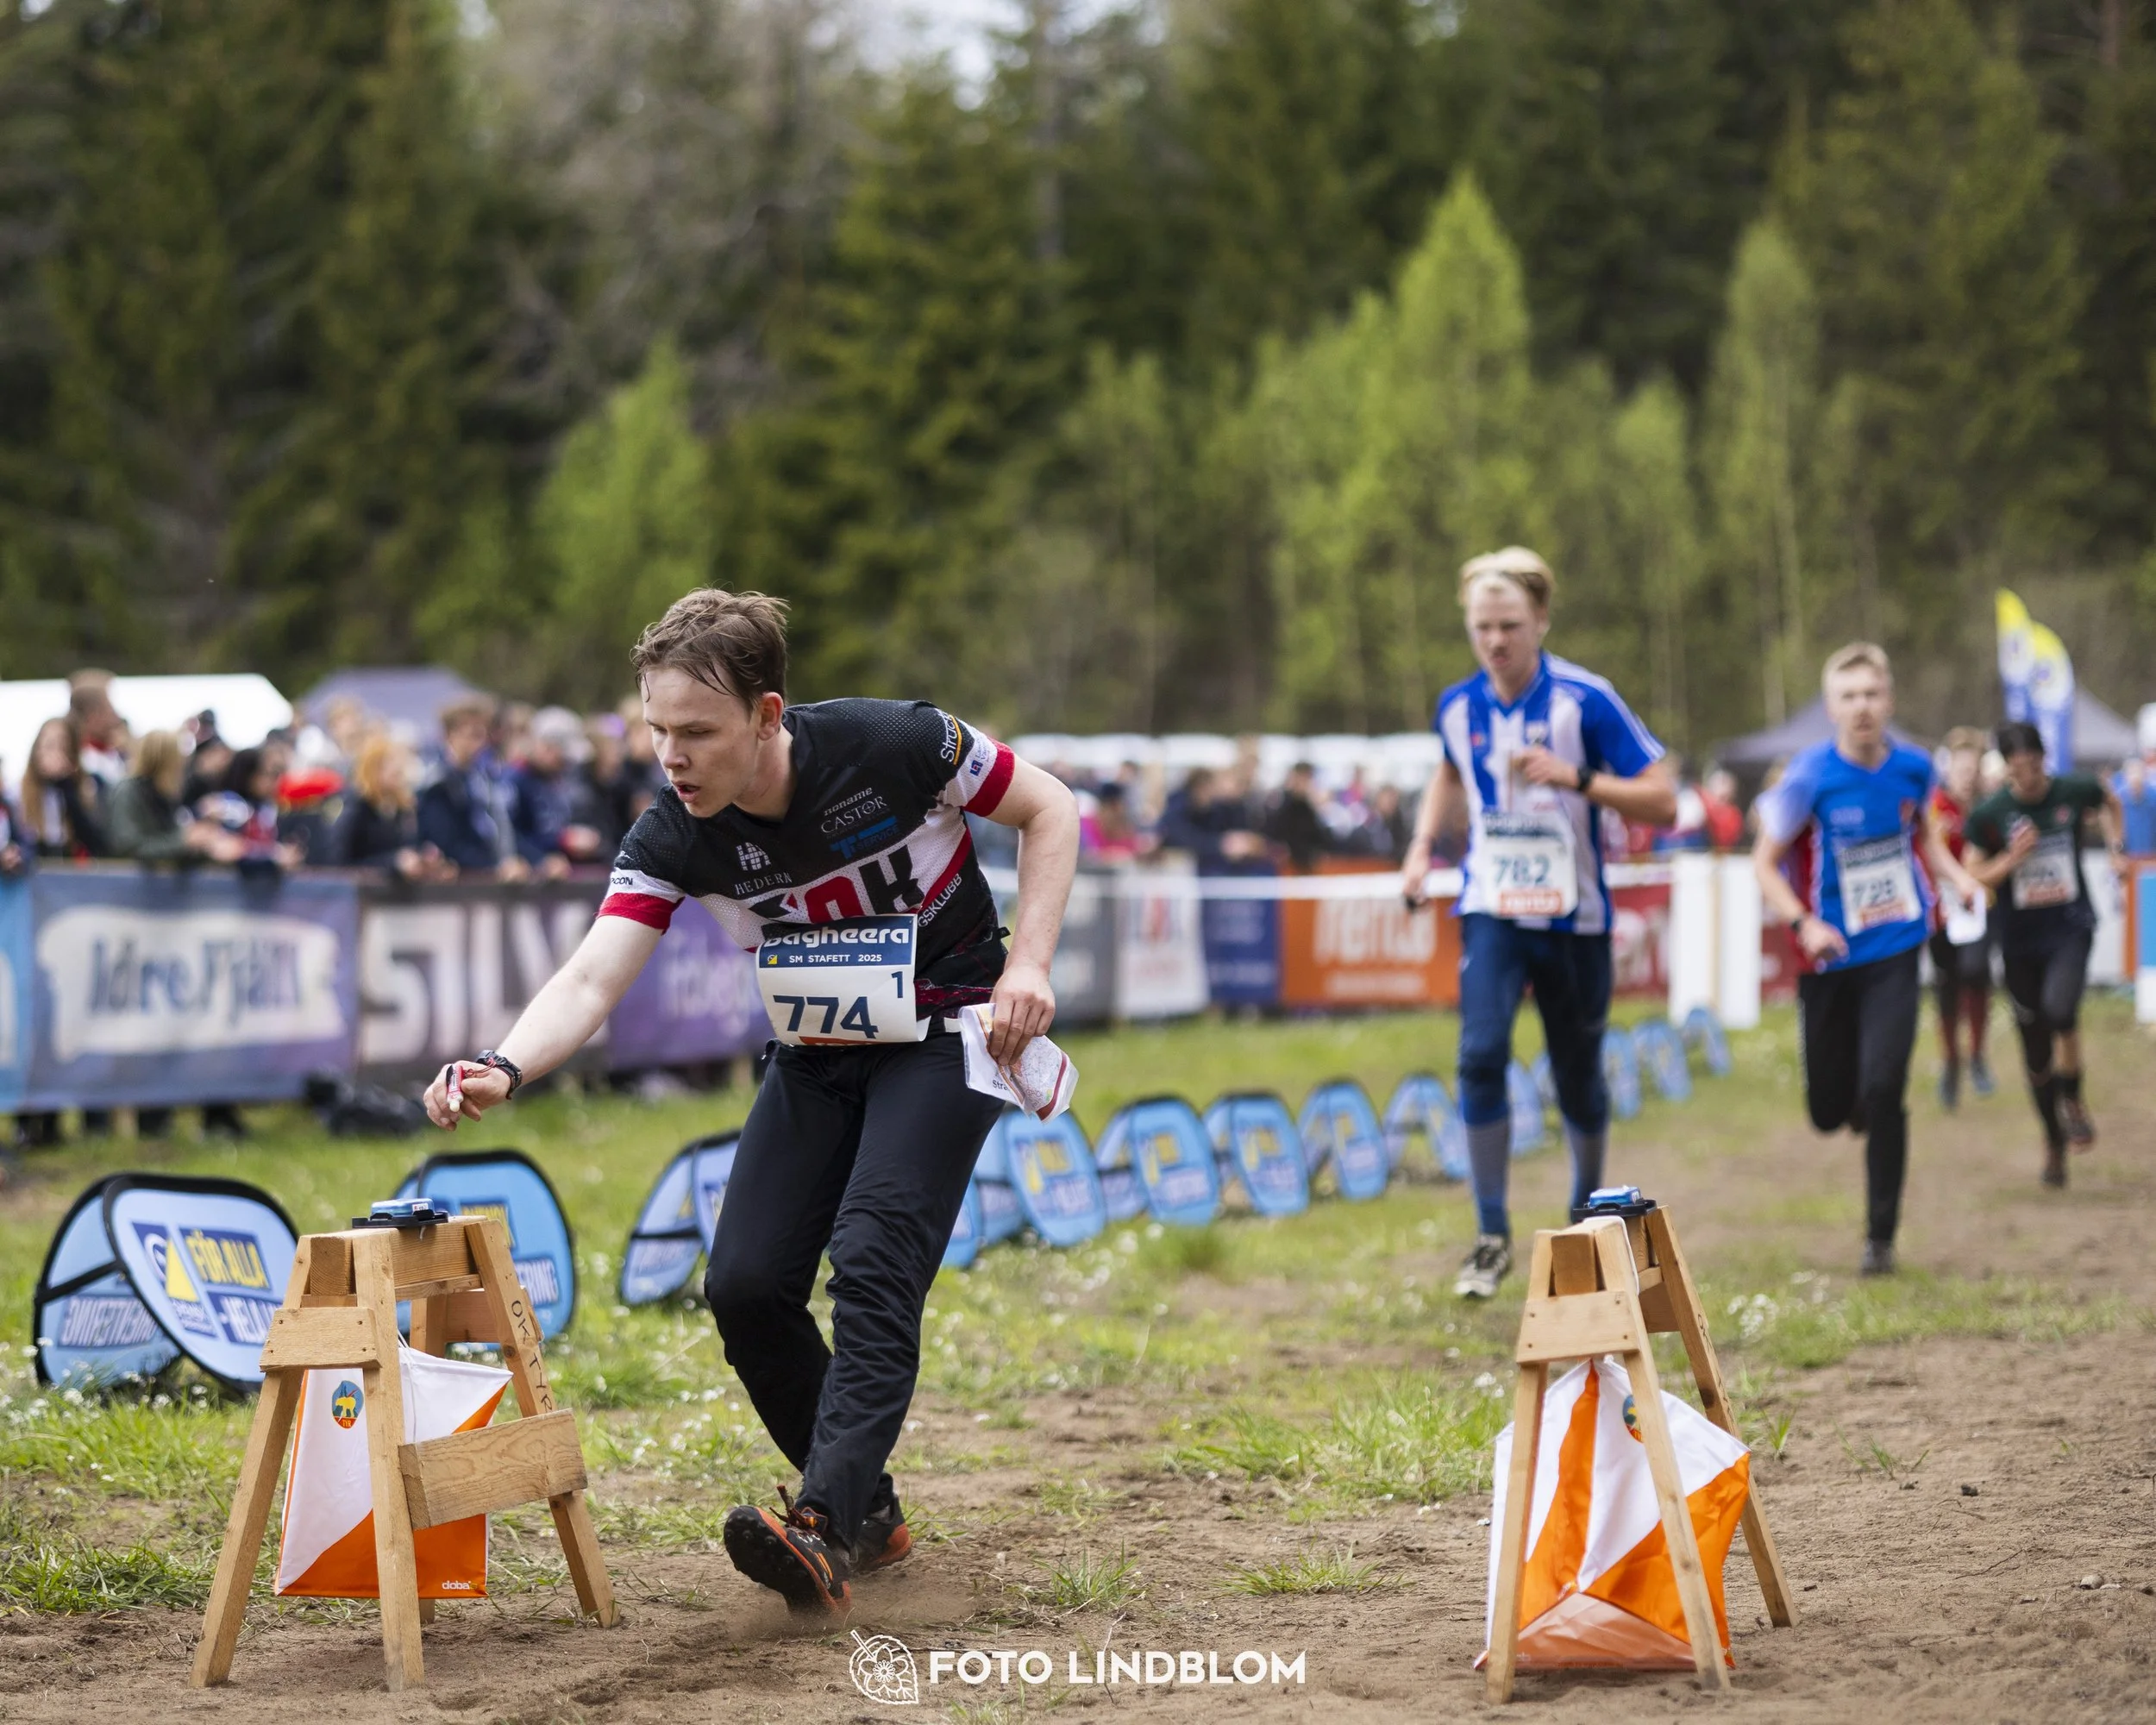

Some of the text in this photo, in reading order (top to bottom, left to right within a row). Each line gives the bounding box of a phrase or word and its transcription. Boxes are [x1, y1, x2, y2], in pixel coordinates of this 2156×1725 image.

[821, 795, 887, 833] CASTOR
[824, 787, 873, 816] noname
[735, 872, 793, 894] HEDERN
[789, 955, 803, 963] SM
[808, 954, 850, 963] STAFETT
[891, 971, 903, 998] 1
[773, 994, 879, 1038] 774
